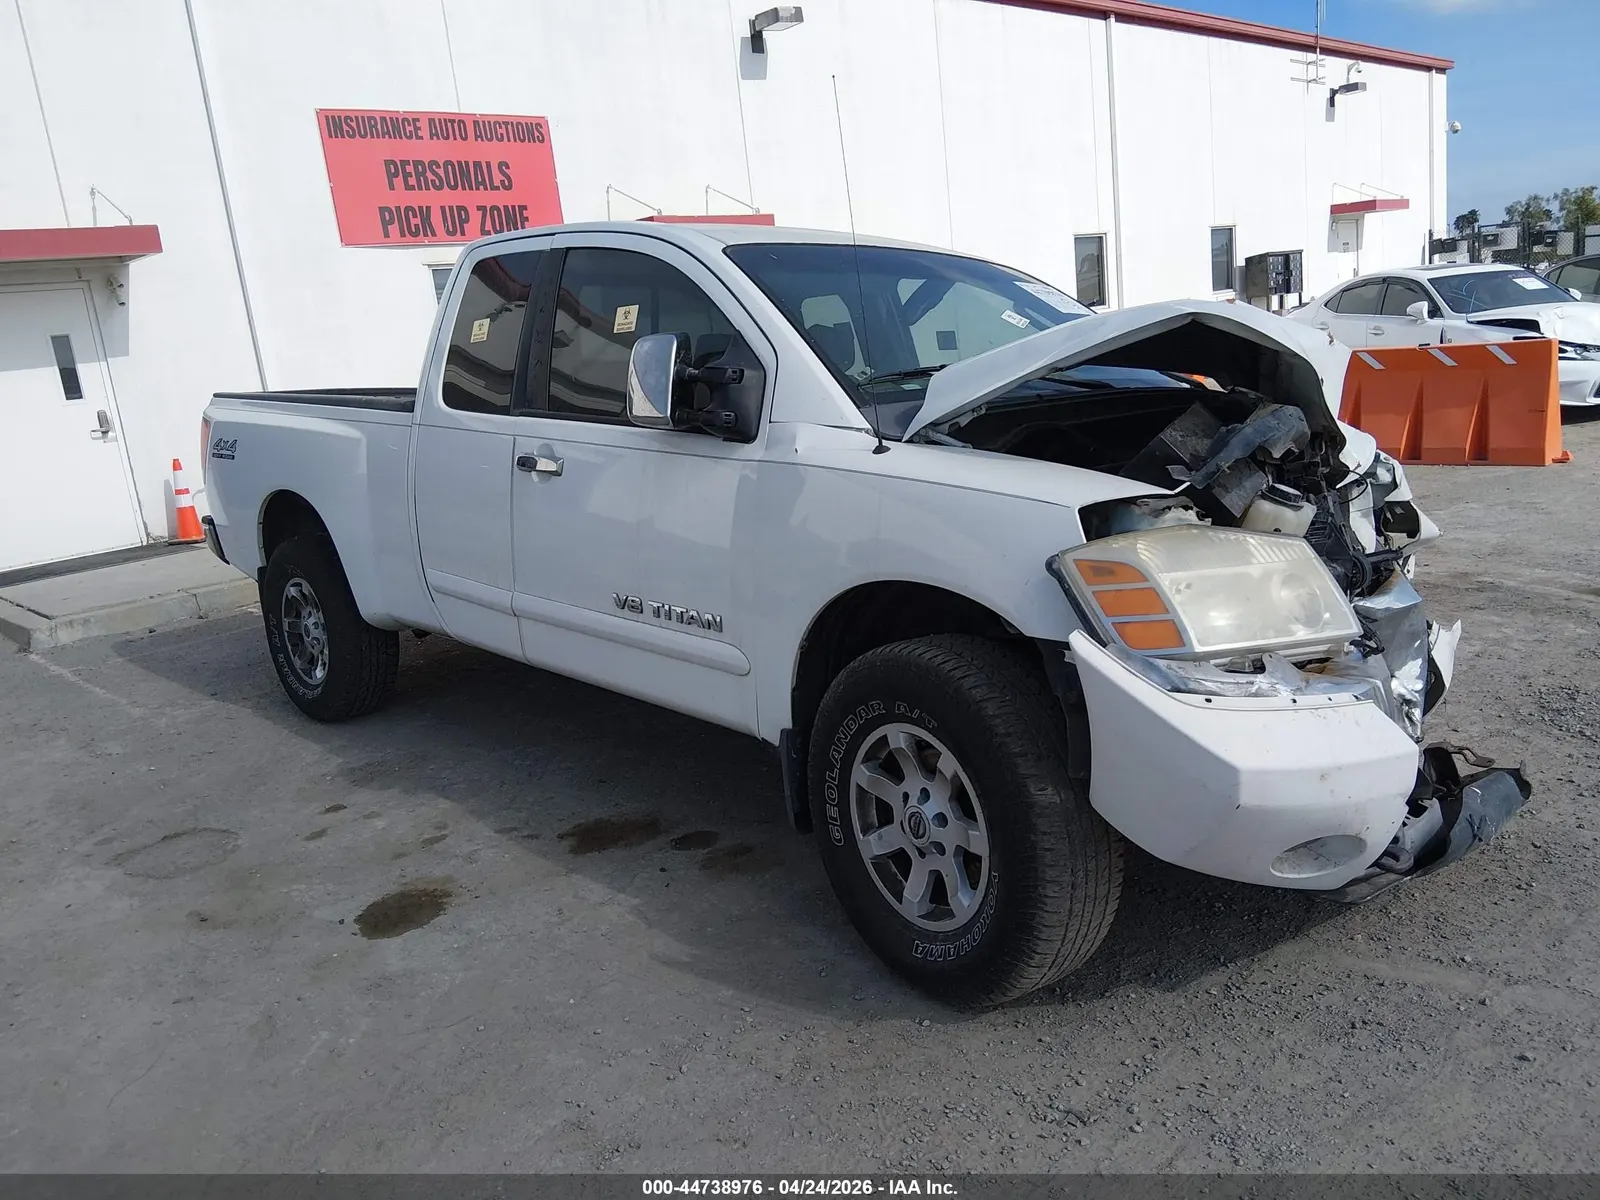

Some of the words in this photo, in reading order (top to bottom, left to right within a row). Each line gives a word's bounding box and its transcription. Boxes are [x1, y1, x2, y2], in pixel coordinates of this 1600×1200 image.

[325, 115, 423, 140] INSURANCE
[428, 118, 468, 142] AUTO
[473, 120, 545, 144] AUCTIONS
[384, 159, 513, 191] PERSONALS
[378, 206, 437, 238] PICK
[440, 205, 470, 236] UP
[612, 592, 643, 614] V8
[648, 600, 723, 633] TITAN
[825, 700, 886, 846] GEOLANDAR
[895, 701, 938, 729] A/T
[912, 870, 999, 961] YOKOHAMA
